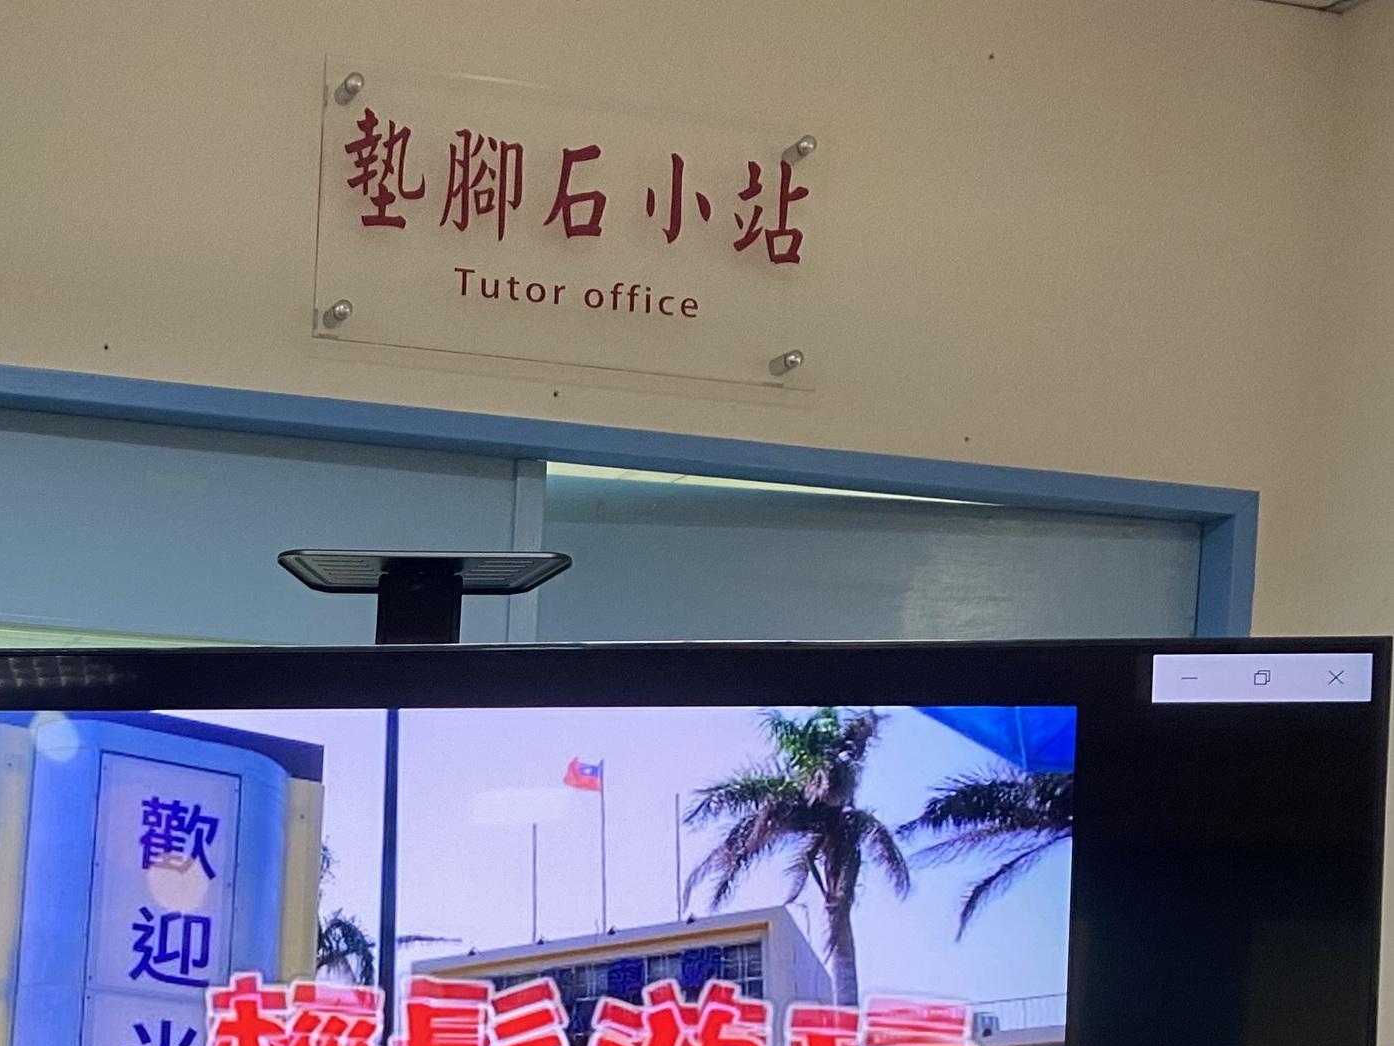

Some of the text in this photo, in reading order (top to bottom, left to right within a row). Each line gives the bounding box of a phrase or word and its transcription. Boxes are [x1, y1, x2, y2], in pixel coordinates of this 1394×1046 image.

[344, 107, 810, 265] 墊腳石小站
[454, 267, 700, 318] Tutor office
